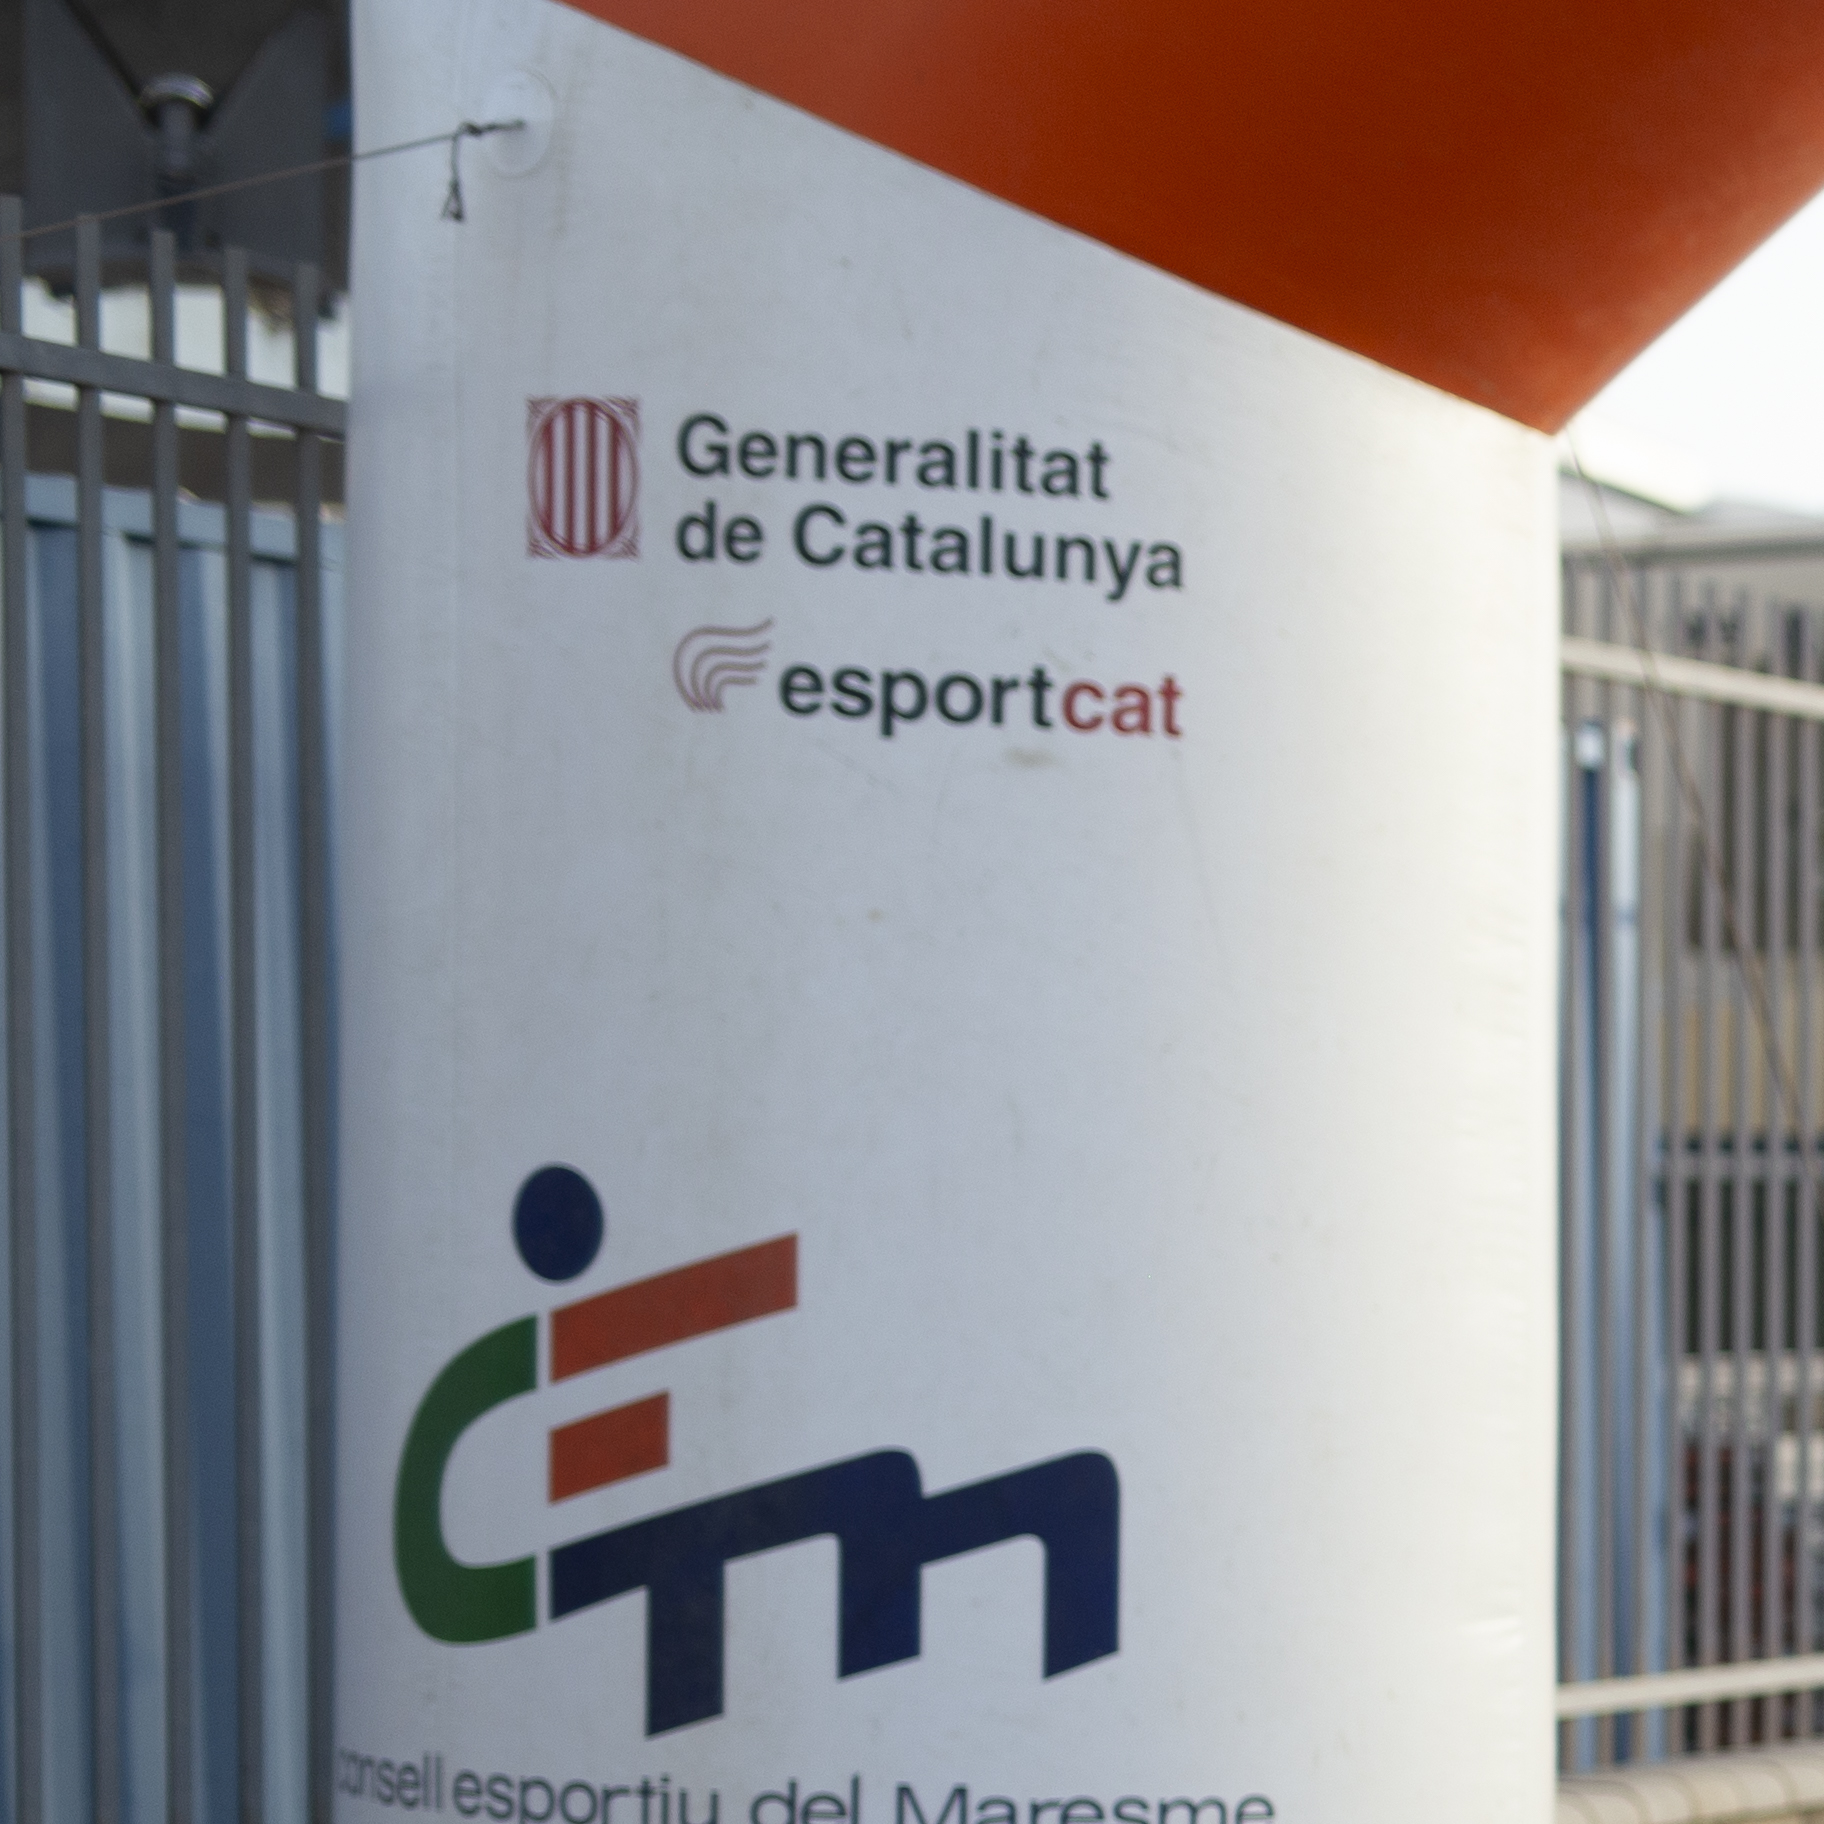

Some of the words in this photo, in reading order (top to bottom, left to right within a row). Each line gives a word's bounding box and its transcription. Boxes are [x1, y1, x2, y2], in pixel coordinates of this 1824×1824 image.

[674, 410, 1112, 503] Generalitat
[673, 497, 767, 566] de
[790, 500, 1185, 605] Catalunya
[775, 661, 1184, 741] esportcat
